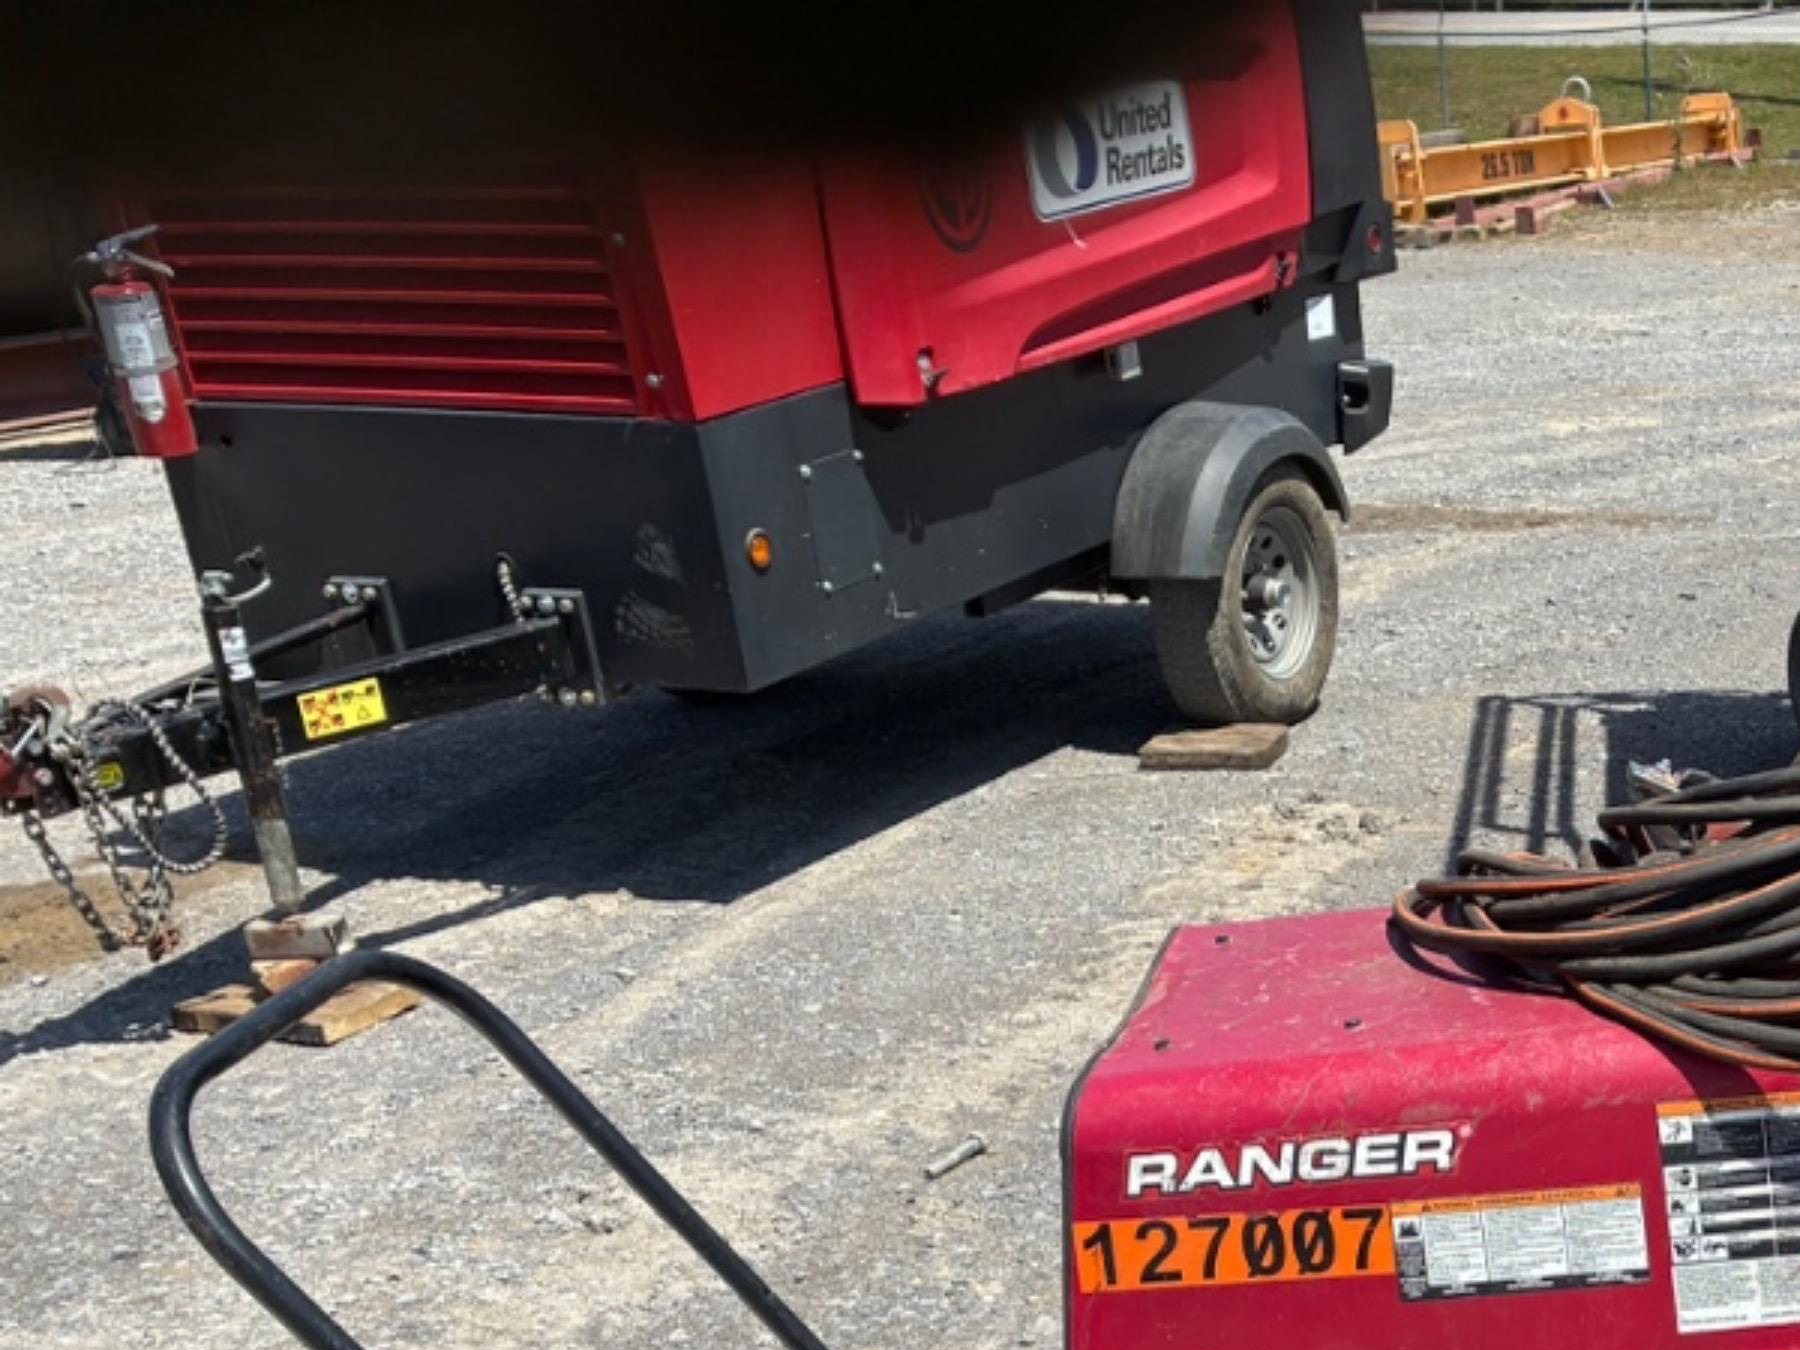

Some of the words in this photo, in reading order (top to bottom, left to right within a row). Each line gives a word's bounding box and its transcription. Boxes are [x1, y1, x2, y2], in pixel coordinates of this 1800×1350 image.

[1098, 91, 1171, 141] United
[1105, 135, 1185, 186] Rentals
[1127, 1130, 1453, 1196] RANGER
[1082, 1208, 1383, 1285] 127007
